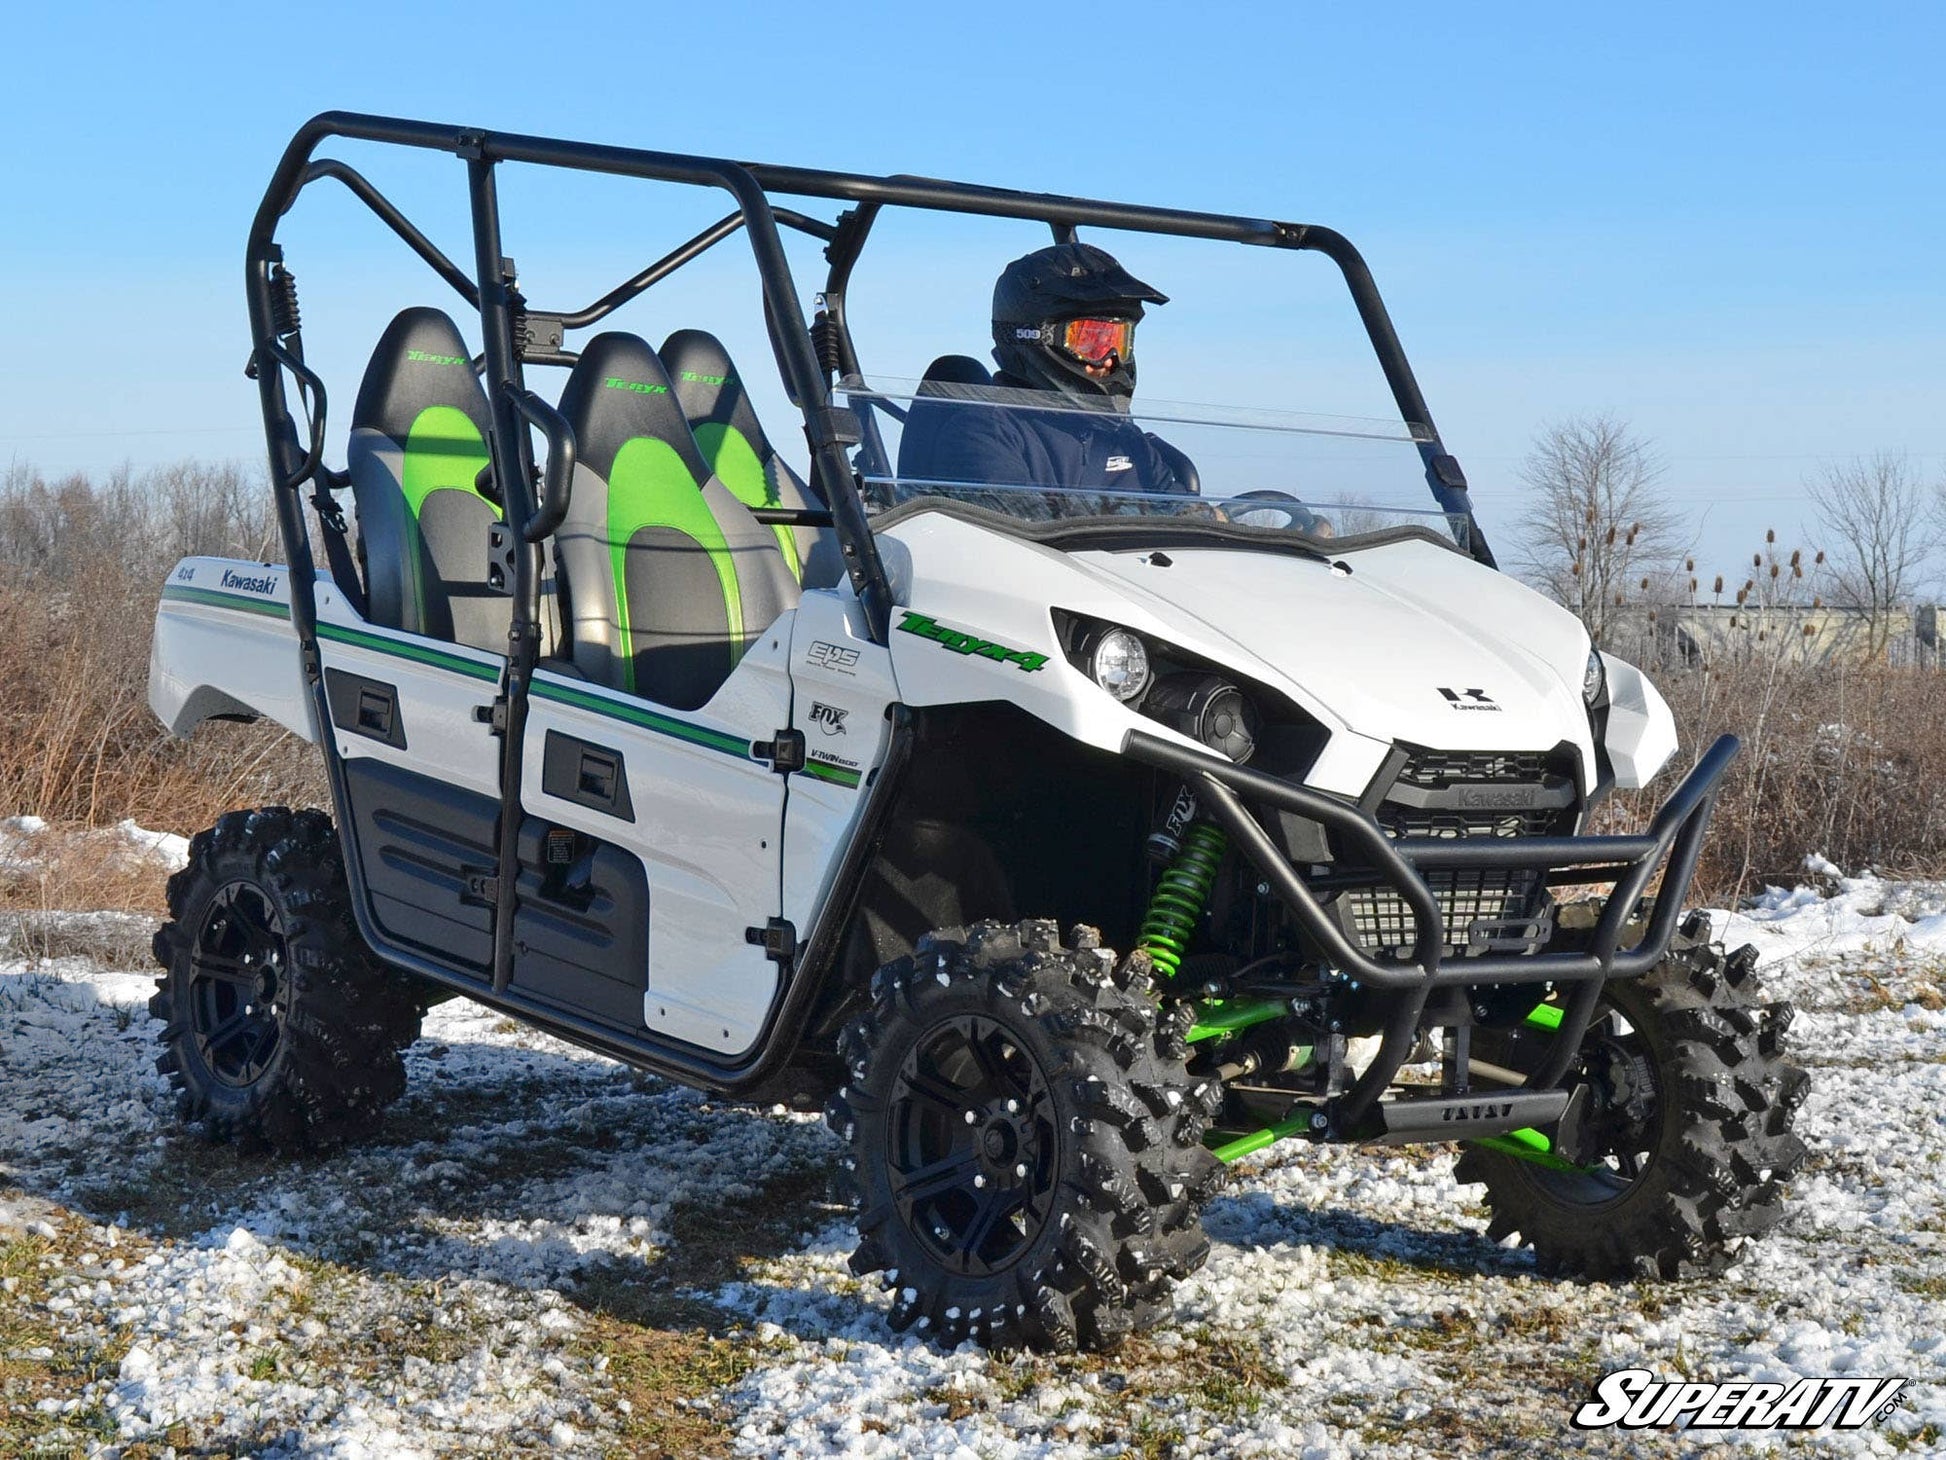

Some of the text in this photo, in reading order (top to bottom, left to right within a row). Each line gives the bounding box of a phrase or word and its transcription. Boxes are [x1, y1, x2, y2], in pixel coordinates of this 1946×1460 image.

[220, 569, 279, 595] Kawasaki
[808, 640, 861, 667] EPS
[808, 701, 849, 727] FOX
[1166, 784, 1197, 837] FOX
